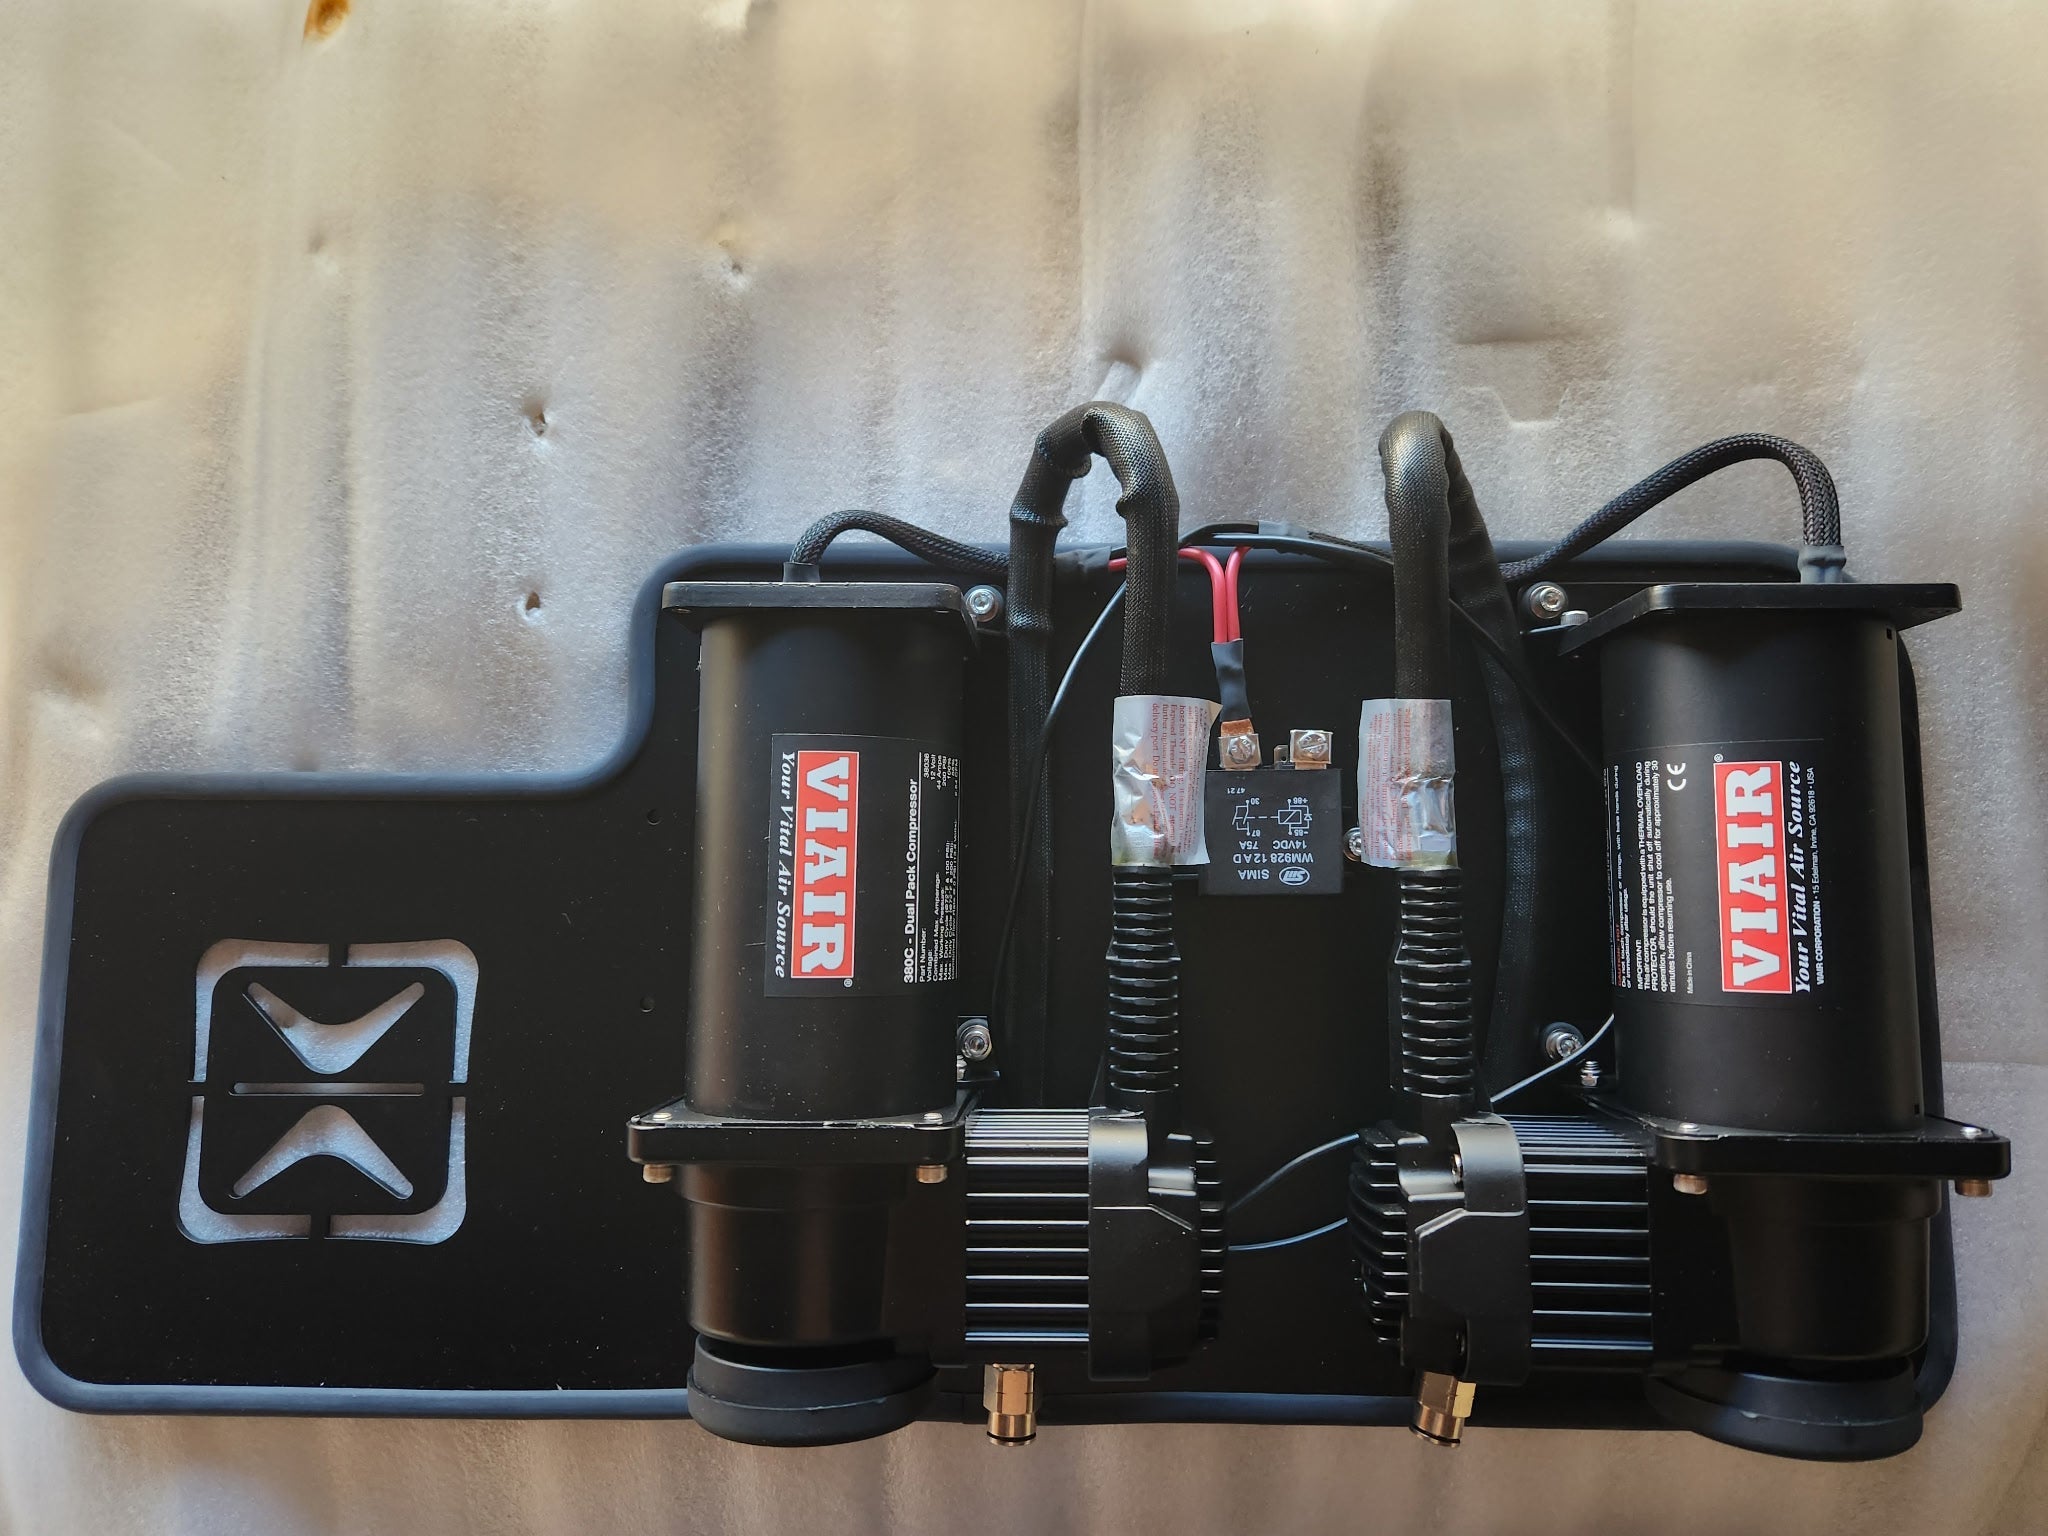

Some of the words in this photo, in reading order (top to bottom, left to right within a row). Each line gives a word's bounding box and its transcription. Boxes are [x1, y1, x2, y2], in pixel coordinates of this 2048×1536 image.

[1151, 704, 1160, 733] delivery
[781, 752, 794, 799] Your
[931, 771, 935, 780] 12
[1153, 755, 1160, 766] Do
[1652, 761, 1658, 770] 30
[937, 780, 941, 790] 44
[1652, 773, 1661, 826] approximately
[1787, 762, 1803, 838] Source
[1807, 791, 1816, 813] 92618
[779, 806, 793, 855] Vital
[906, 779, 918, 862] Compressor
[1809, 814, 1816, 825] CA
[1239, 841, 1258, 849] 75A
[1272, 840, 1307, 848] 14VDC
[1809, 828, 1818, 848] Irvine,
[801, 757, 850, 973] VIAIR
[1270, 853, 1313, 862] WM928
[1789, 843, 1805, 878] Air
[1810, 850, 1820, 883] Edelman,
[778, 862, 791, 896] Air
[906, 866, 915, 899] Pack
[1238, 870, 1269, 879] SIMA
[1640, 873, 1649, 908] equipped
[1726, 767, 1780, 986] VIAIR
[1812, 885, 1820, 893] 15
[905, 904, 914, 934] Dual
[1656, 881, 1665, 928] compressor
[1666, 896, 1674, 932] resuming
[1791, 883, 1808, 936] Vital
[775, 901, 790, 978] Source
[1658, 930, 1666, 950] allow
[1667, 934, 1675, 959] before
[1813, 901, 1823, 961] CORPORATION
[904, 948, 913, 983] 380C
[1650, 936, 1658, 991] PROTECTOR,
[1660, 952, 1668, 992] operation,
[1668, 961, 1676, 992] minutes
[1794, 942, 1810, 992] Your
[1816, 963, 1824, 984] VIAIR
